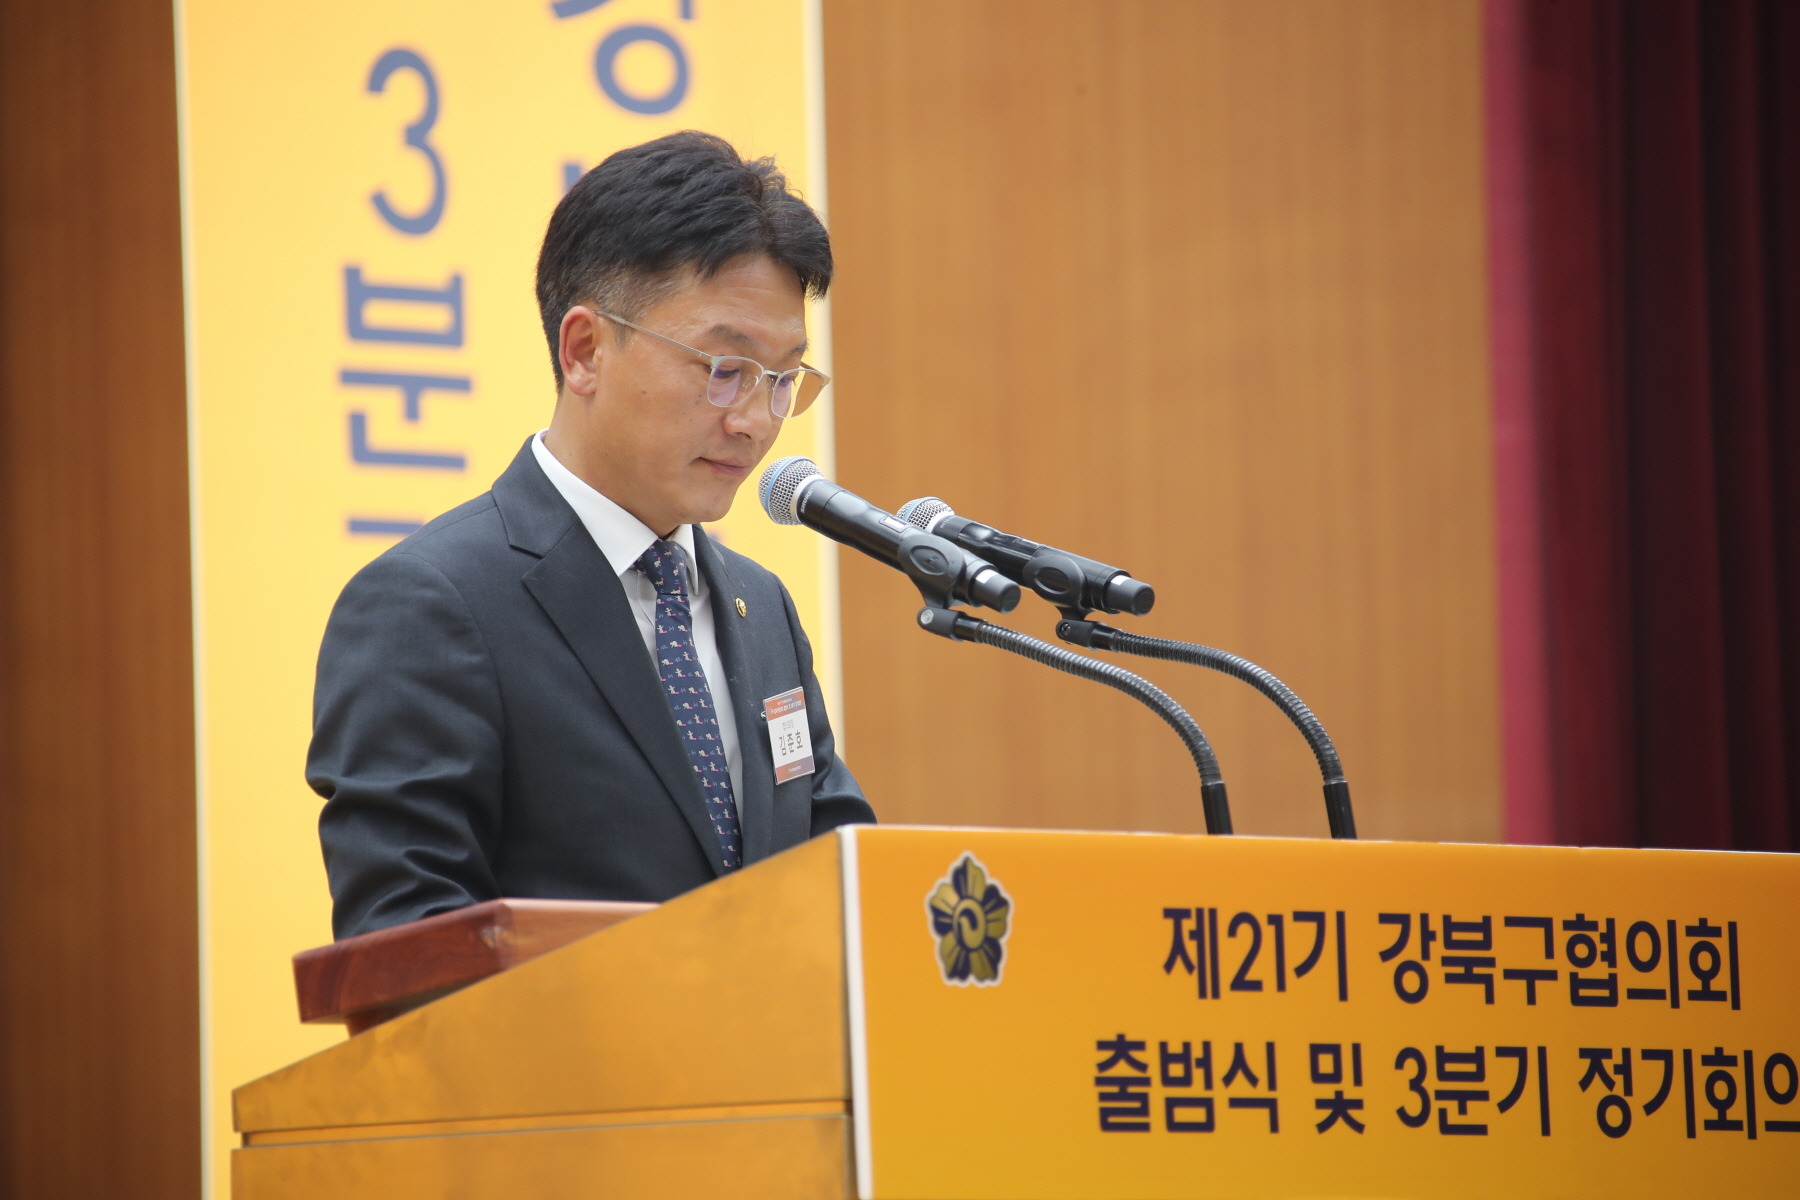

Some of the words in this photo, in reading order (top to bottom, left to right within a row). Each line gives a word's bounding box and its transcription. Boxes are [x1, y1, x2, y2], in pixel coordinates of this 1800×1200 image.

[341, 48, 471, 540] 3분
[778, 730, 804, 756] 김준호
[1162, 906, 1349, 1003] 제21기
[1377, 912, 1742, 1011] 강북구협의회
[1094, 1033, 1280, 1134] 출범식
[1308, 1042, 1366, 1135] 및
[1394, 1045, 1552, 1137] 3분기
